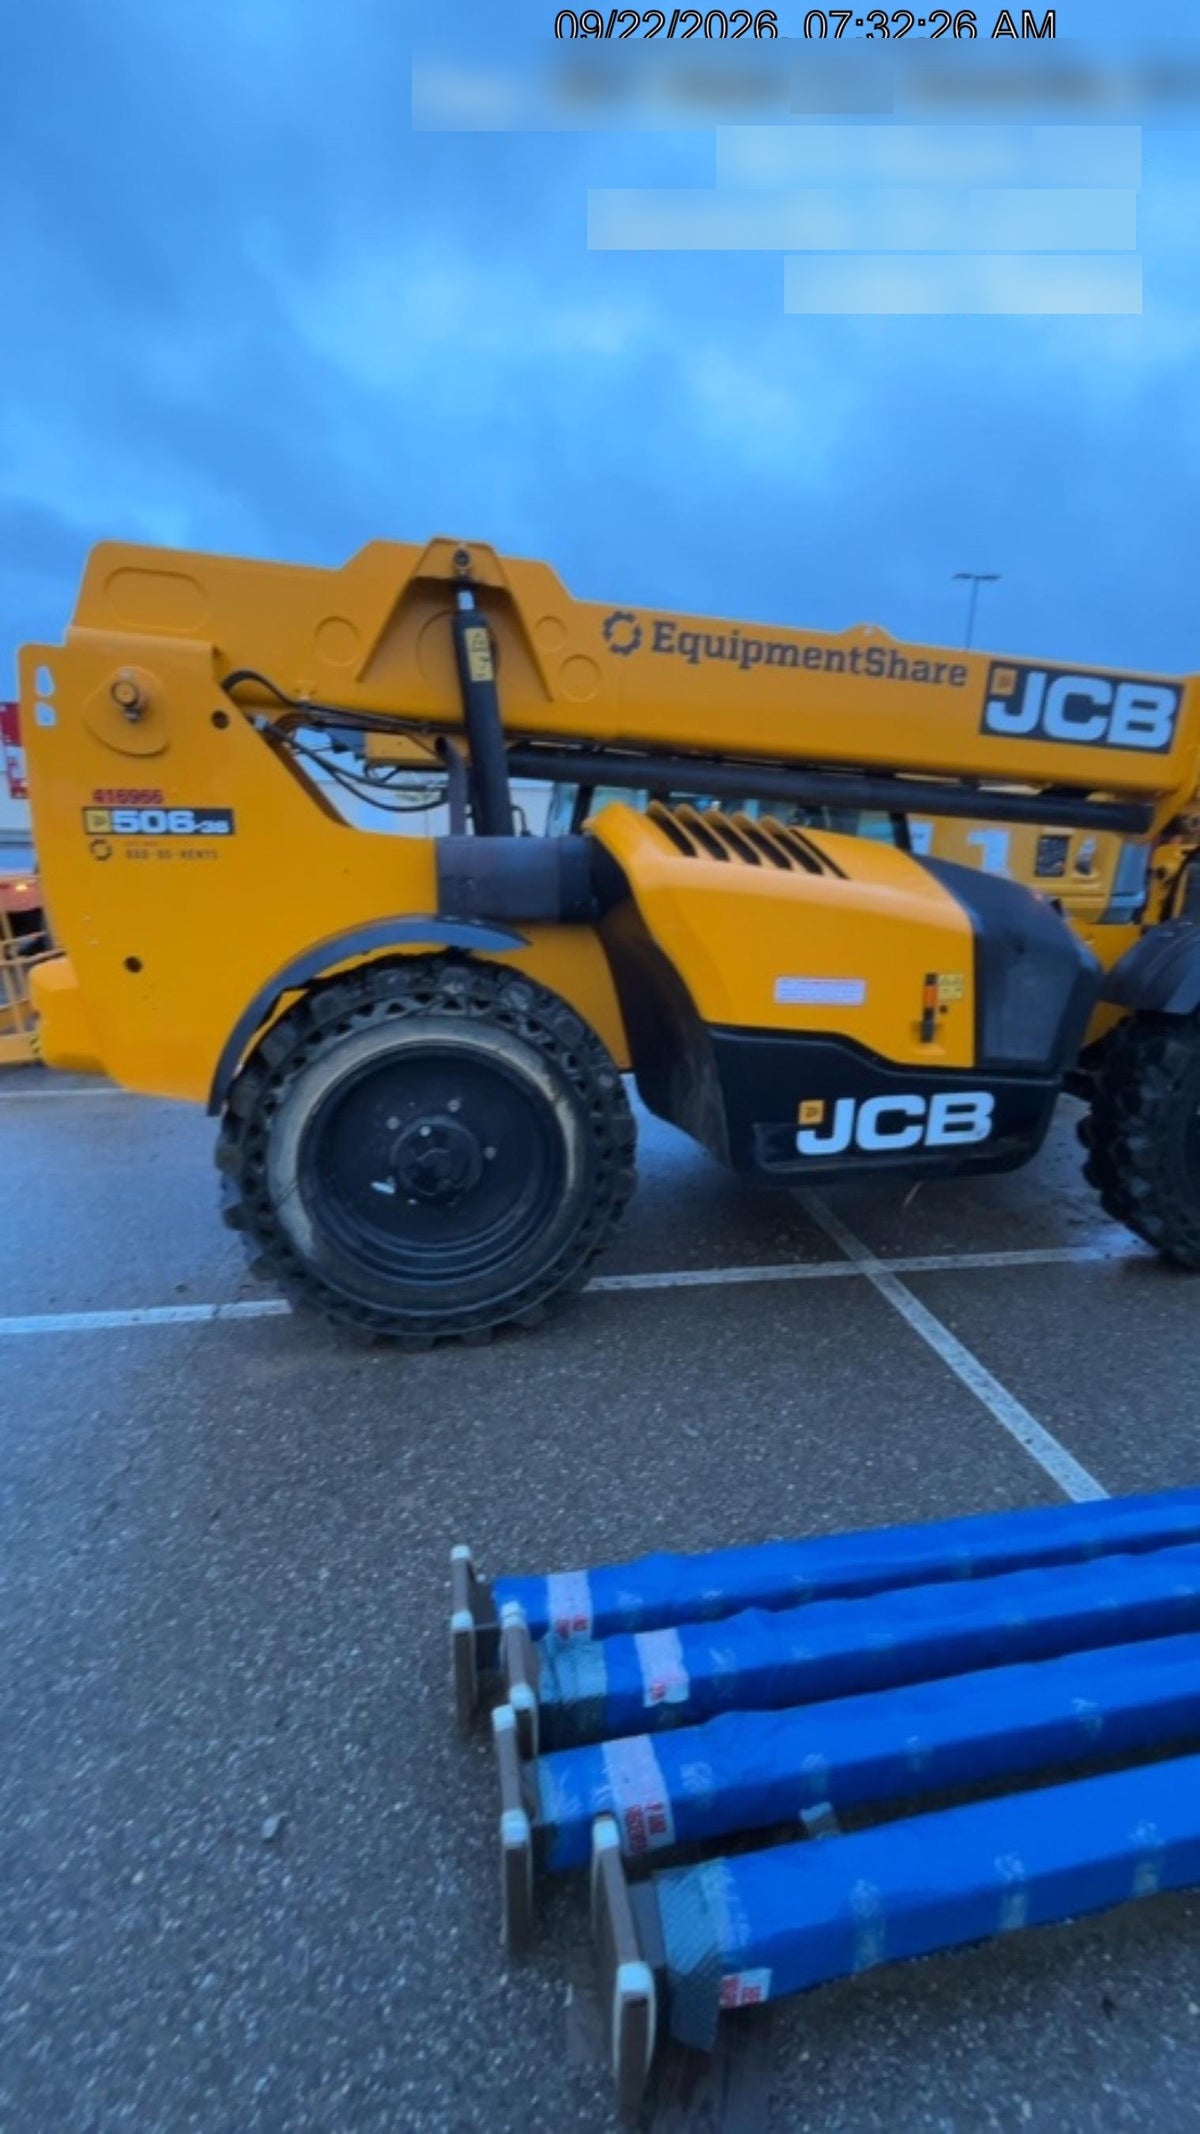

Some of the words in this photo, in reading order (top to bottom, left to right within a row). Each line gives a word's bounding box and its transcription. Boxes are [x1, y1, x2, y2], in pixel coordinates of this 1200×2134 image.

[652, 620, 968, 687] EquipmentShare
[986, 670, 1178, 749] JCB
[796, 1090, 995, 1156] JCB
